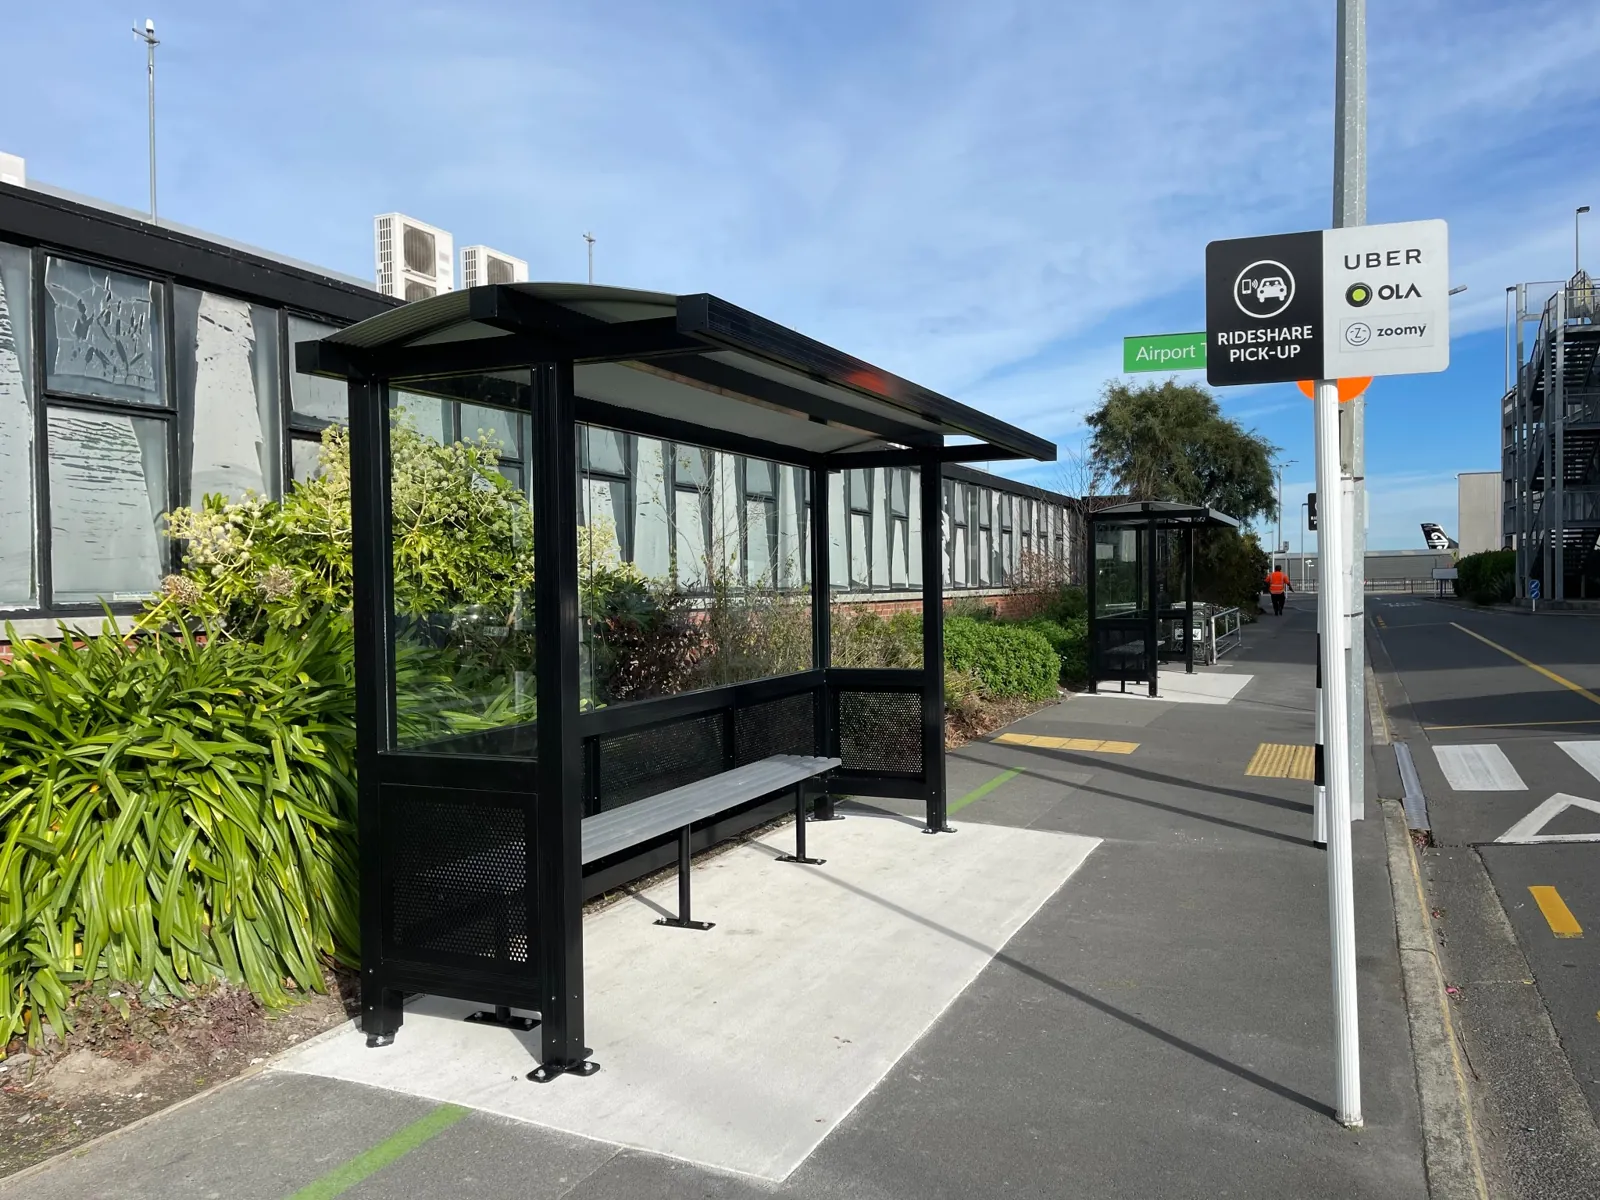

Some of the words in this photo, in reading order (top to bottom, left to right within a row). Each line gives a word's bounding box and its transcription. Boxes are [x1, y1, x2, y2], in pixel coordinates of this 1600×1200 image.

[1344, 248, 1422, 270] UBER
[1378, 282, 1422, 301] OLA
[1217, 325, 1313, 345] RIDESHARE
[1377, 325, 1427, 338] zoomy
[1135, 345, 1196, 363] Airport
[1229, 344, 1301, 362] PICK-UP
